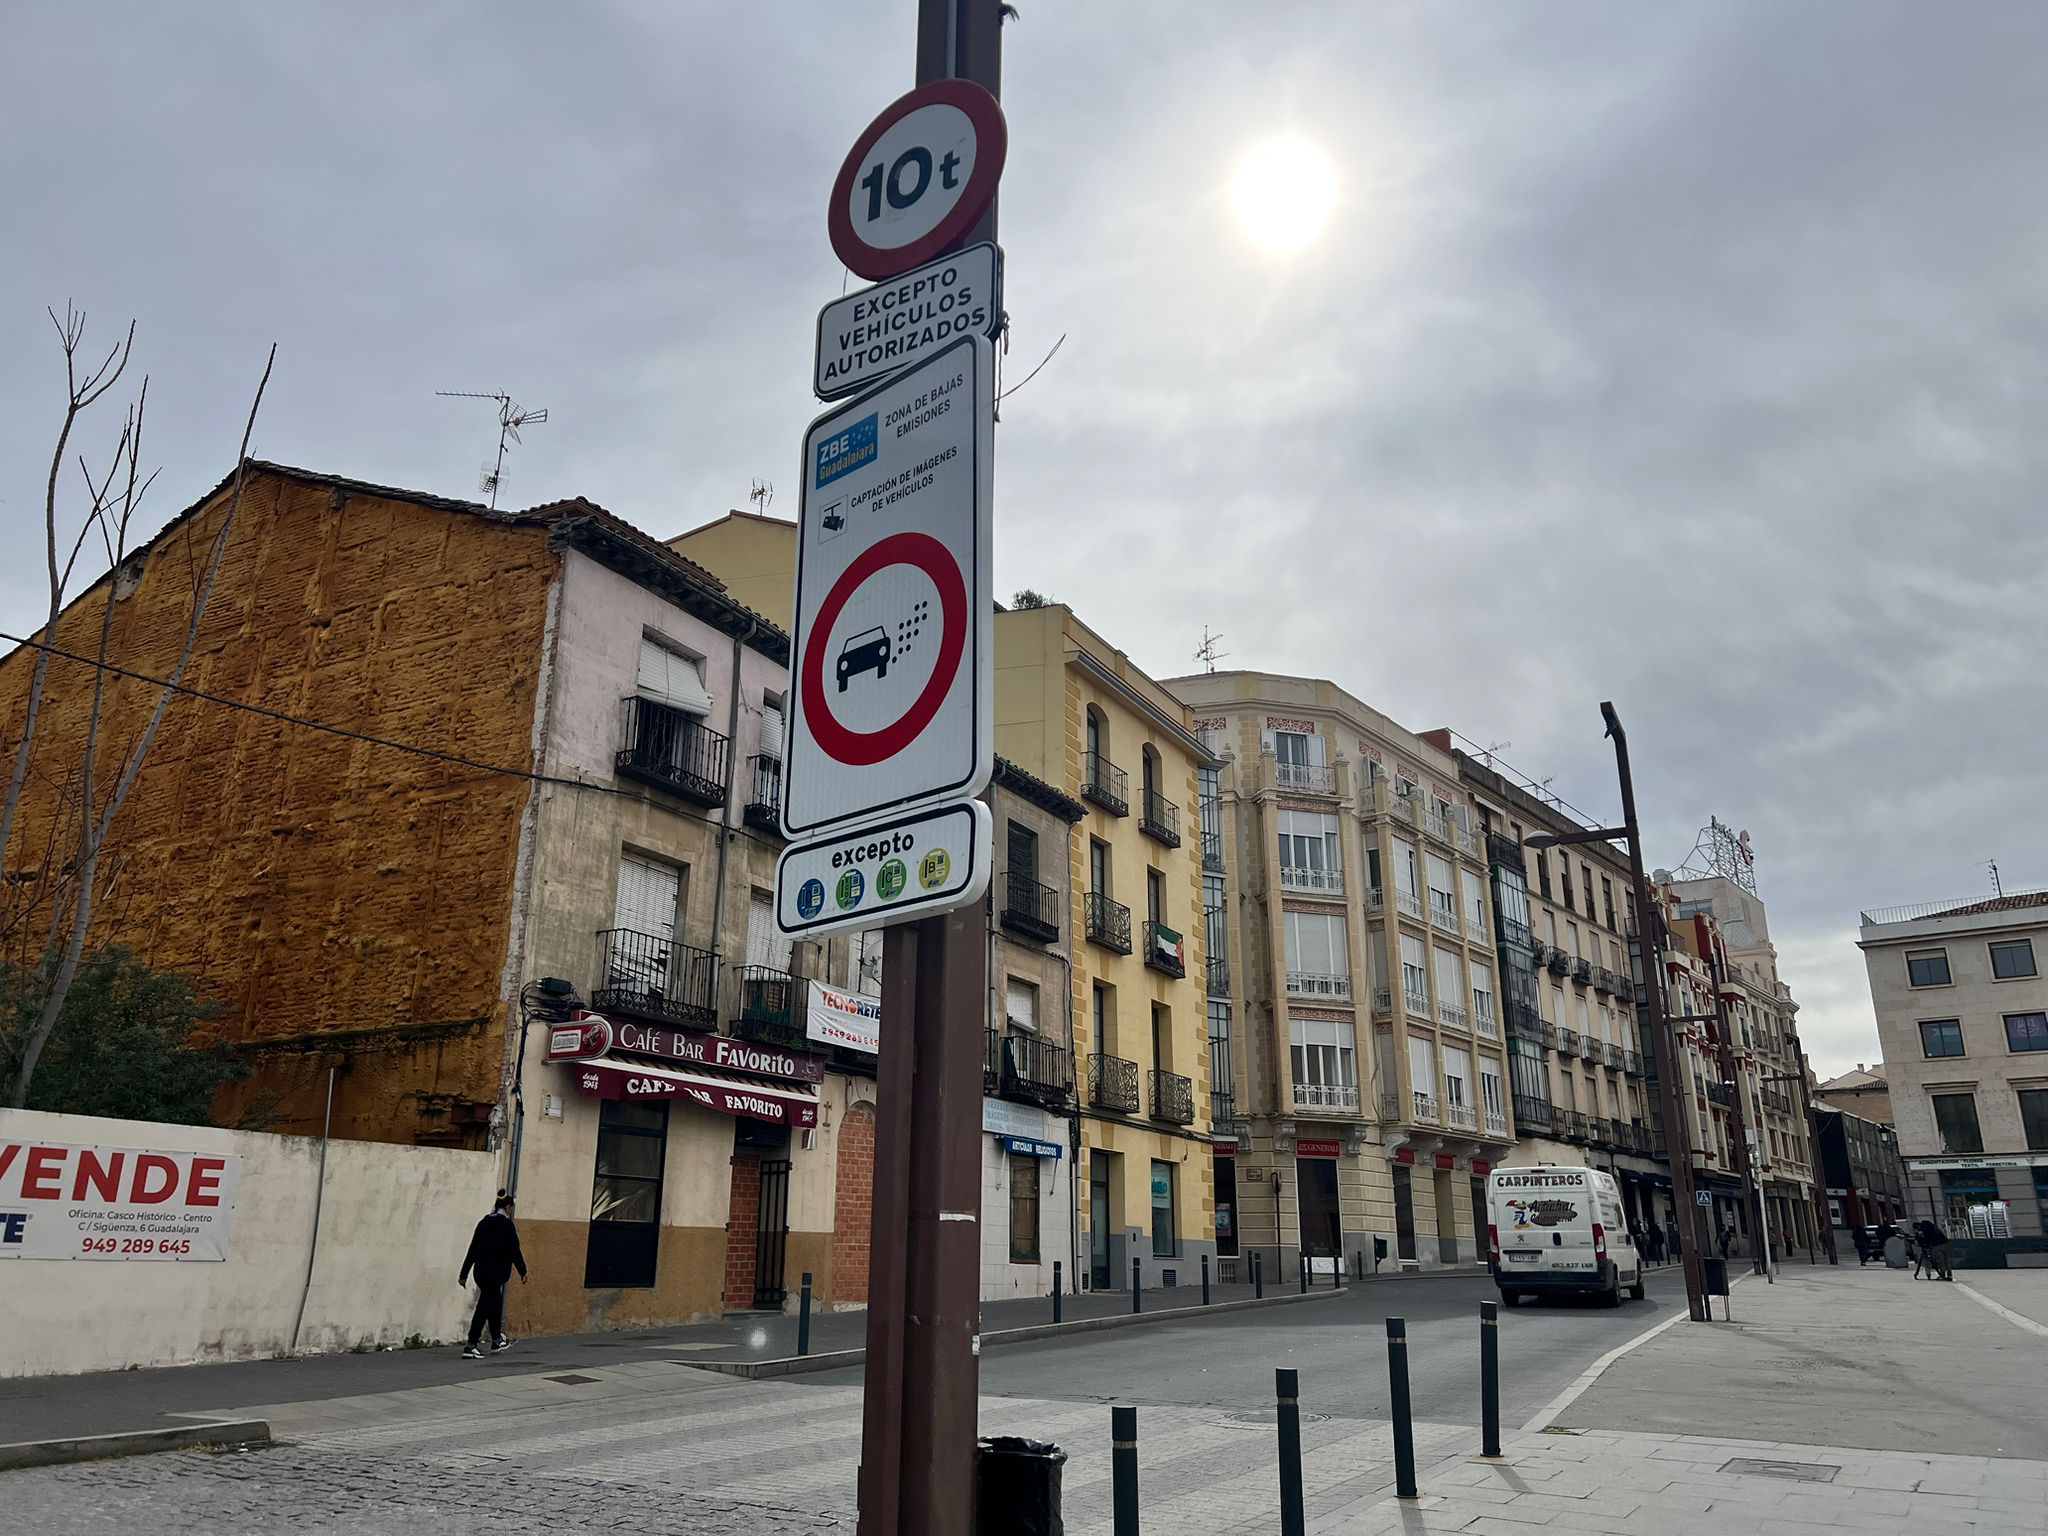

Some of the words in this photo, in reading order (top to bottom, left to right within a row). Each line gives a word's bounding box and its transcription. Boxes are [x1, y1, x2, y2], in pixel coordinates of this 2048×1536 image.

[862, 146, 932, 222] 10
[939, 149, 961, 190] t
[853, 267, 957, 322] EXCEPTO
[839, 286, 972, 351] VEHÍCULOS
[824, 306, 985, 381] AUTORIZADOS
[885, 408, 912, 427] ZONA
[915, 394, 928, 410] DE
[931, 374, 963, 401] BAJAS
[897, 399, 951, 438] EMISIONES
[820, 434, 850, 464] ZBE
[820, 443, 875, 479] Guadalajara
[851, 476, 897, 508] CAPTACIÓN
[899, 470, 911, 485] DE
[913, 446, 957, 476] IMÁGENES
[872, 500, 883, 512] DE
[886, 473, 934, 506] VEHÍCULOS
[831, 832, 914, 868] excepto
[928, 861, 936, 873] B
[724, 1095, 783, 1118] FAVORITO
[1307, 1144, 1339, 1153] GENERALI
[1497, 1175, 1583, 1187] CARPINTEROS
[68, 1209, 105, 1220] Oficina:
[107, 1211, 135, 1220] Casco
[136, 1211, 176, 1222] Histórico
[183, 1213, 213, 1222] Centro
[93, 1222, 138, 1233] Sigüenza,
[140, 1223, 146, 1232] 6
[147, 1223, 200, 1235] Guadalajara
[82, 1237, 117, 1253] 949
[121, 1238, 154, 1253] 289
[158, 1239, 191, 1254] 645
